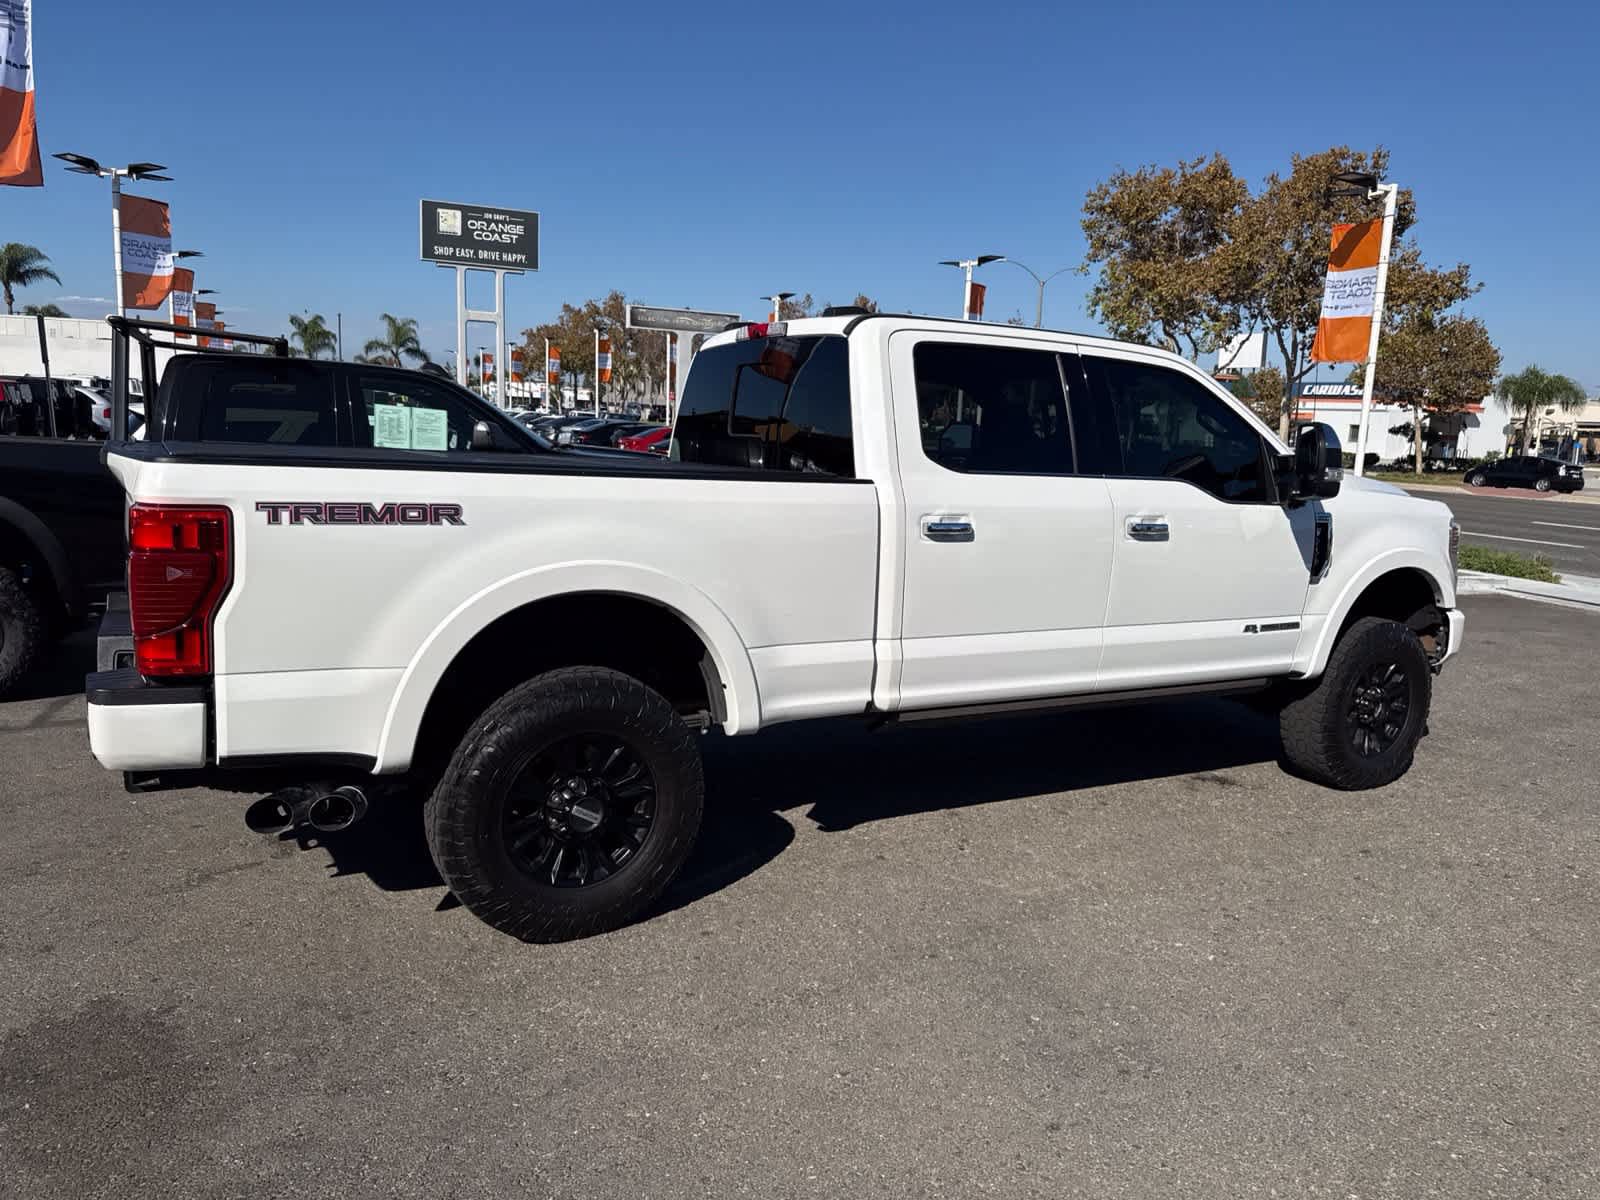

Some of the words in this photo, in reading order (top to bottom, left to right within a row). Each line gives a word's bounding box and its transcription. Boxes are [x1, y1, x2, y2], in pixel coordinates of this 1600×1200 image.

[467, 219, 525, 235] ORANGE
[473, 230, 518, 244] COAST
[433, 245, 454, 257] SHOP
[455, 247, 476, 259] EASY.
[478, 249, 500, 261] DRIVE
[502, 252, 528, 264] HAPPY.
[255, 501, 468, 526] TREMOR
